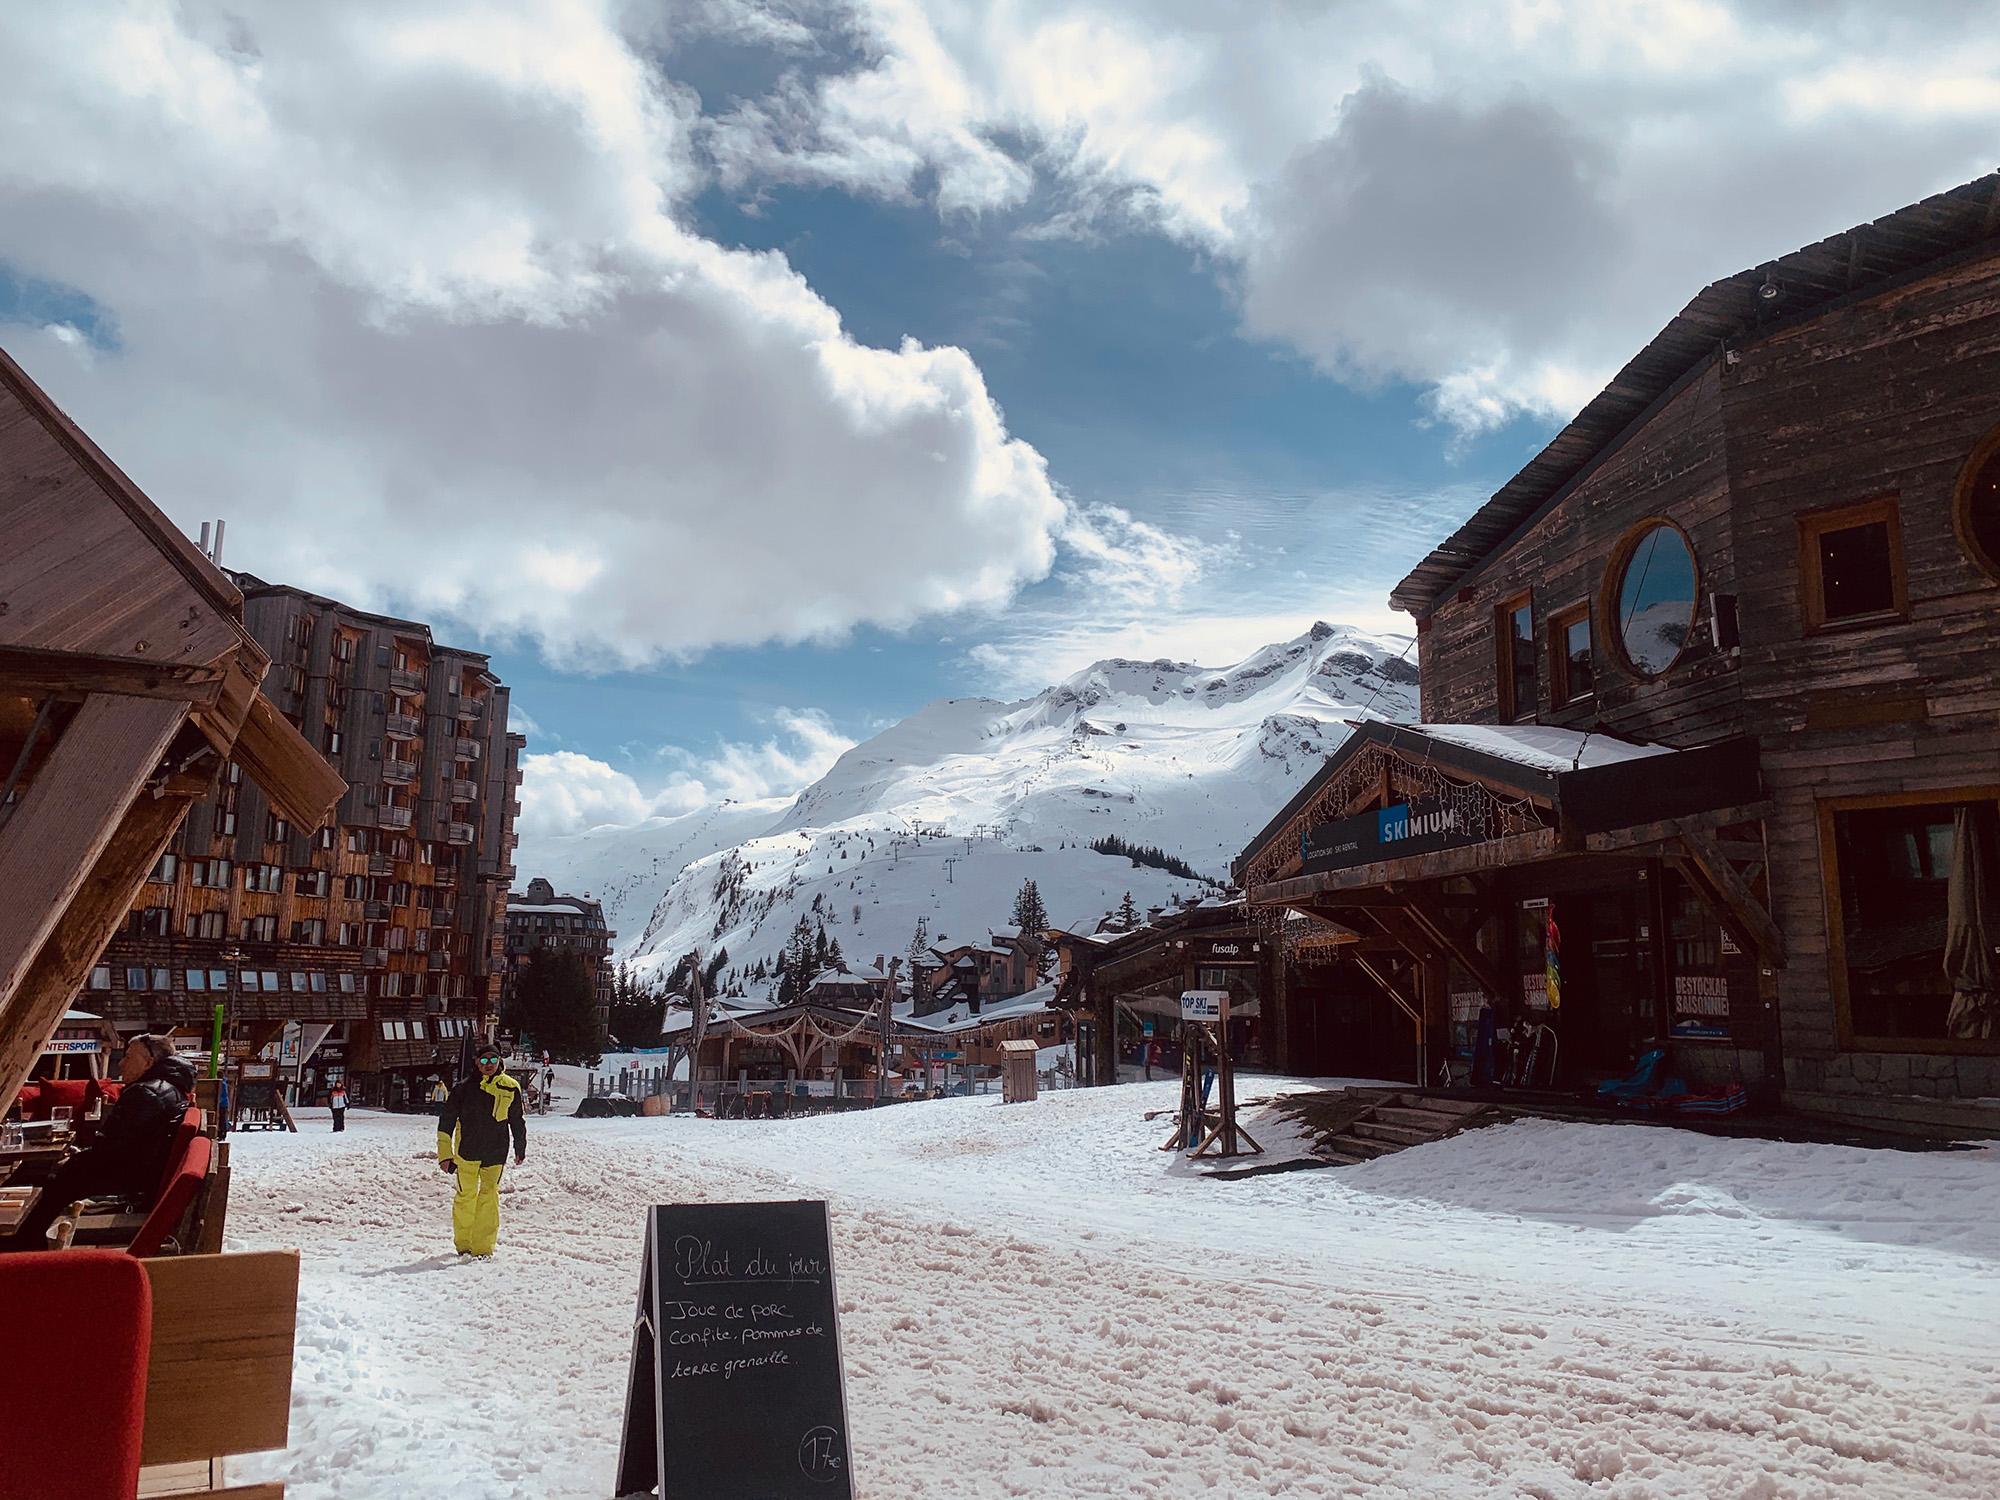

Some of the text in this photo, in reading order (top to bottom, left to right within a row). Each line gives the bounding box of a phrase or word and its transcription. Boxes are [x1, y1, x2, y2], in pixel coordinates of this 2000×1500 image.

[1385, 809, 1454, 842] SKIMIUM
[1306, 848, 1326, 860] LOCATION
[1342, 841, 1359, 852] RENTAL
[1211, 943, 1239, 956] fusalp
[1523, 973, 1547, 990] DESTOC
[1675, 976, 1728, 996] DESTOCKAG
[1182, 997, 1207, 1009] TOP SKI
[1524, 989, 1549, 1006] SAISON
[1675, 994, 1730, 1016] SAISONNIE
[45, 1042, 98, 1051] NTERSPORT
[675, 1235, 826, 1291] Plat du jour
[665, 1300, 718, 1320] Joue
[724, 1302, 745, 1320] de
[742, 1327, 802, 1345] pommes
[805, 1321, 826, 1337] de
